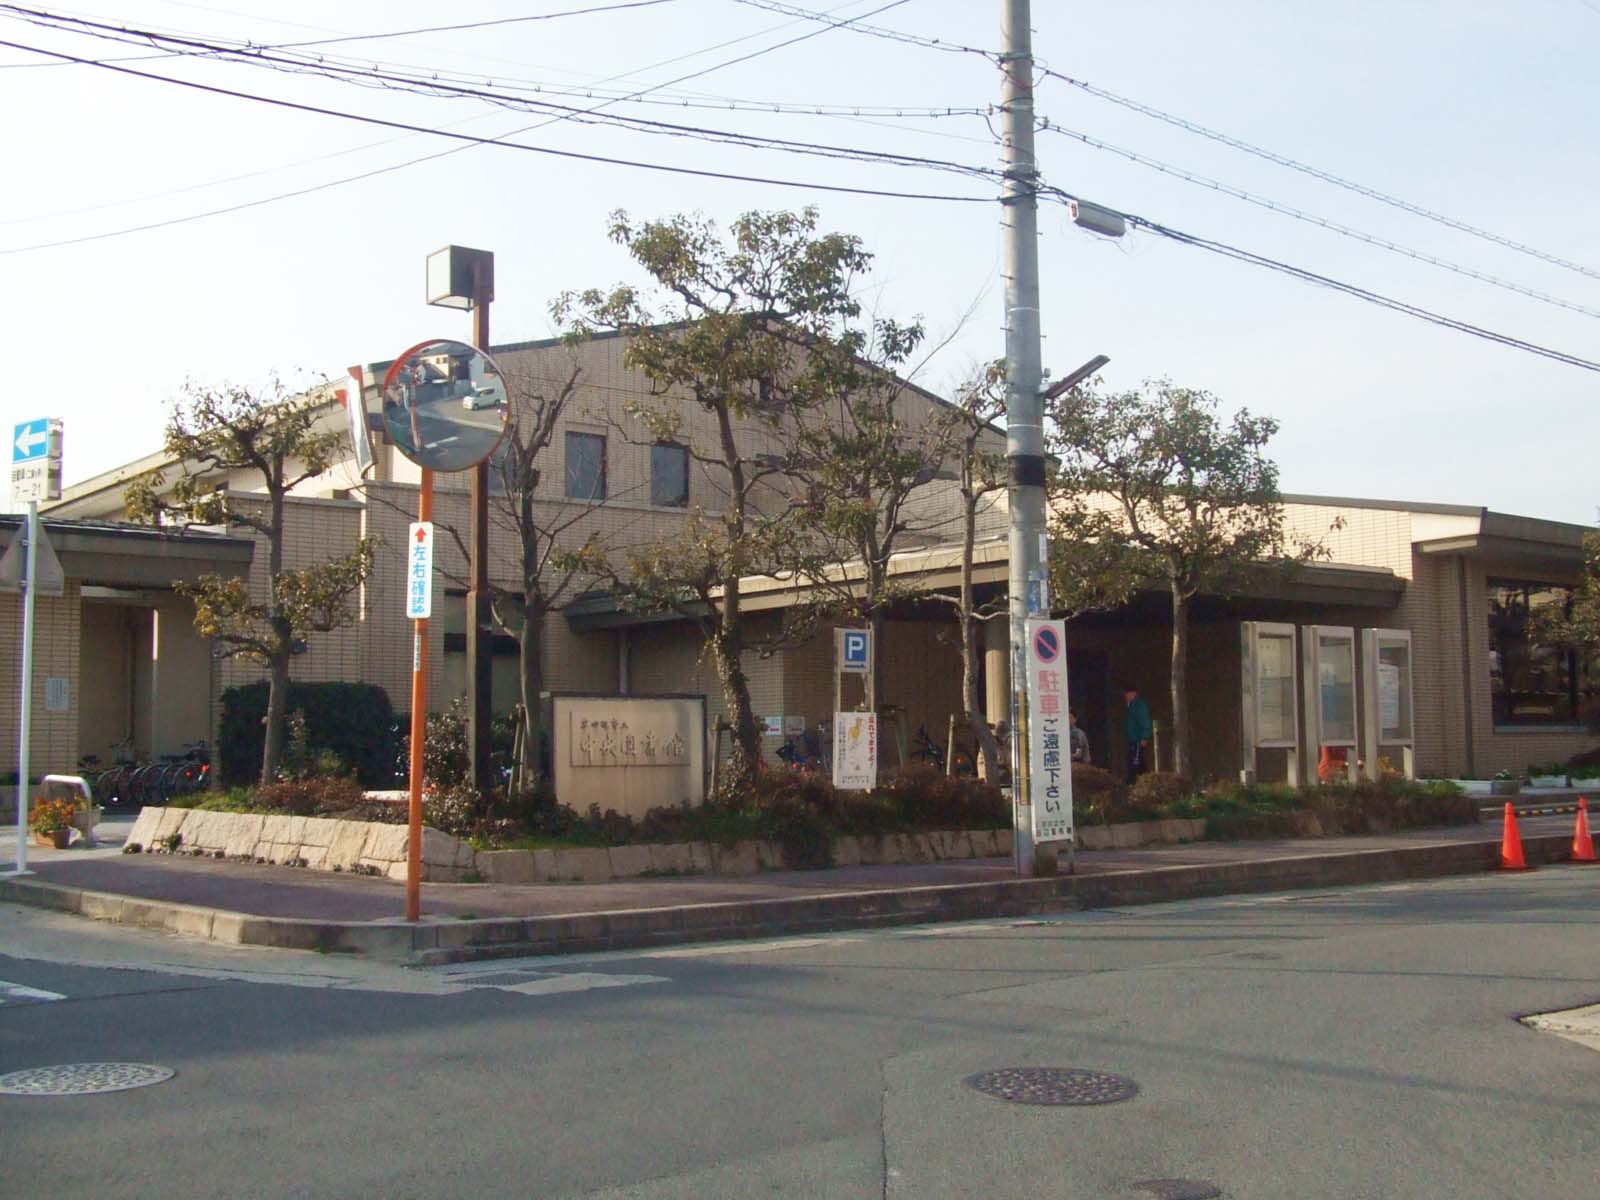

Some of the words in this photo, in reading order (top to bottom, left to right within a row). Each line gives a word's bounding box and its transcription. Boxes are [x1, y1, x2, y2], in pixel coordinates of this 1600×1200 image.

[411, 544, 426, 614] 左右確認
[848, 636, 864, 660] P
[1039, 669, 1061, 814] 駐車ご遠慮下さい
